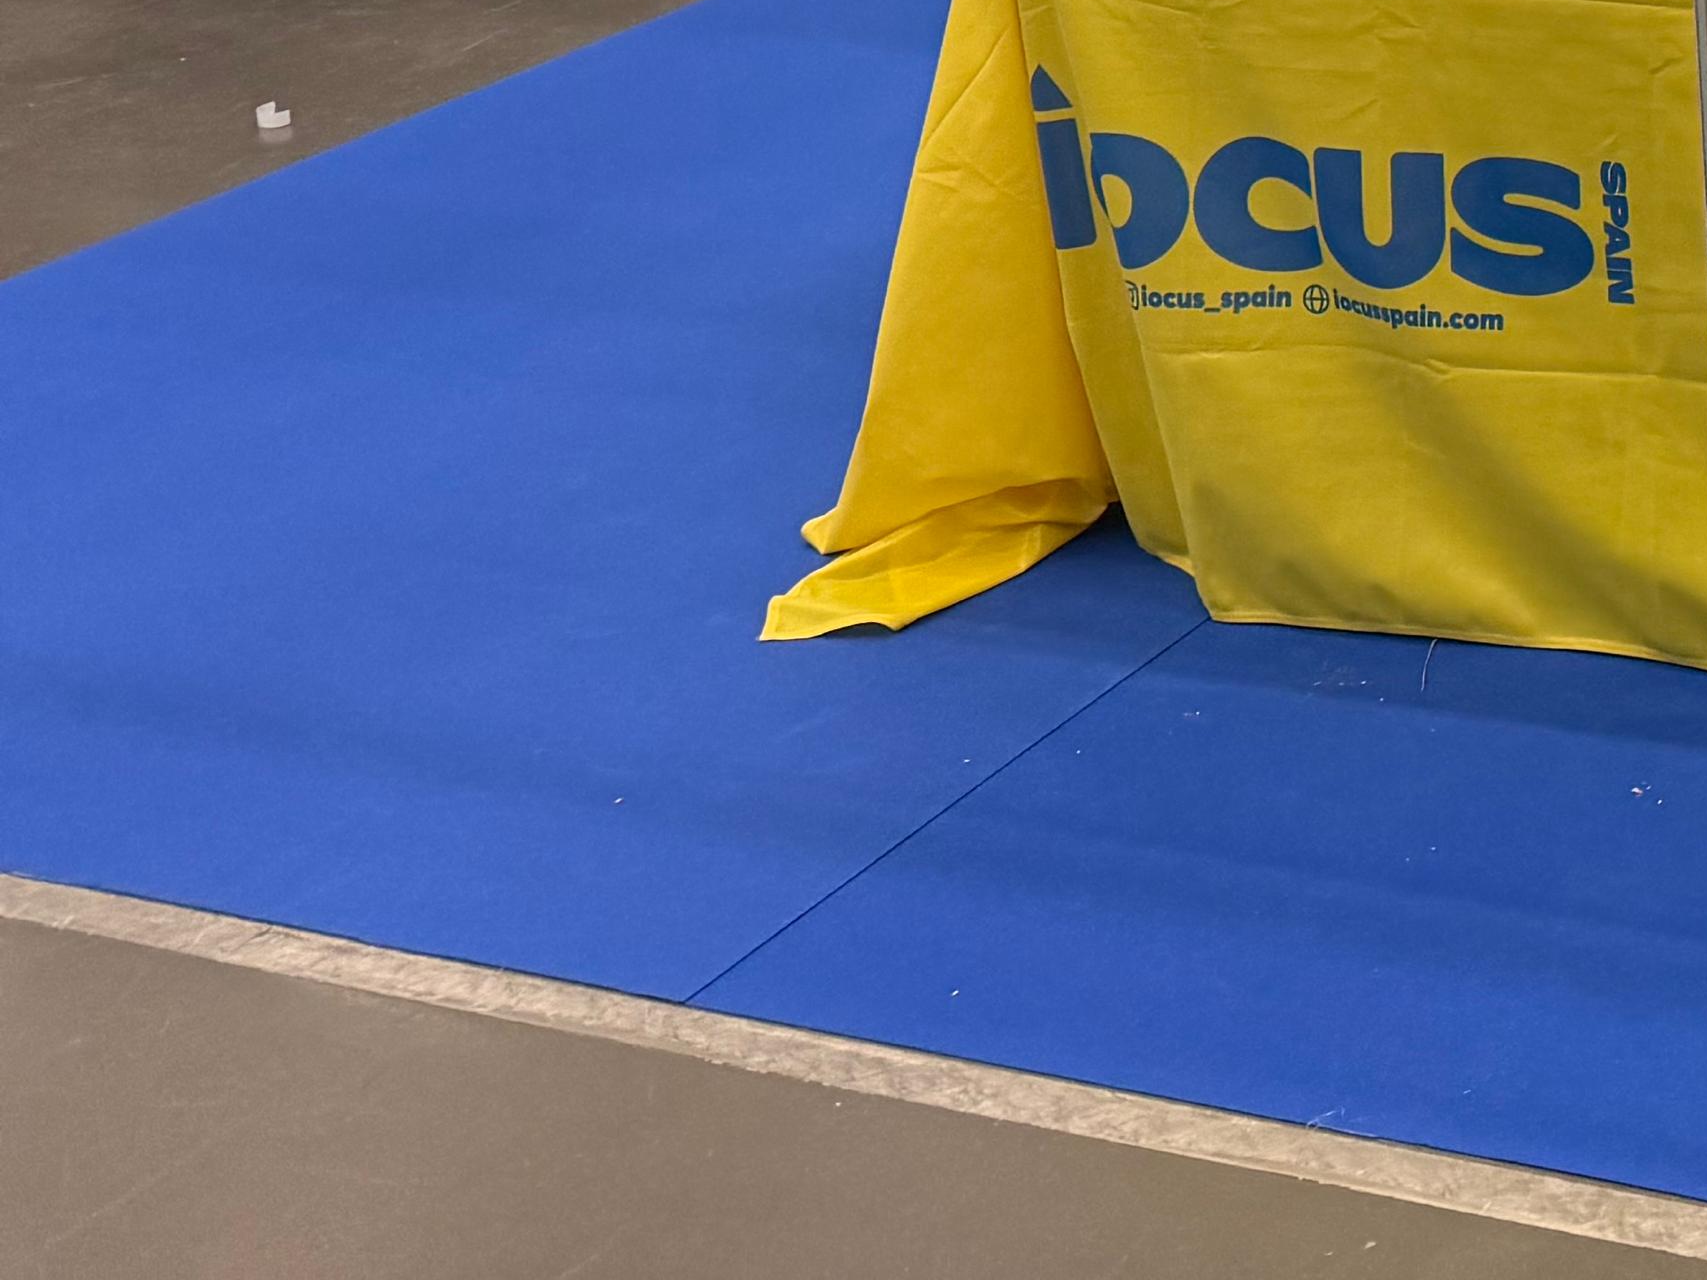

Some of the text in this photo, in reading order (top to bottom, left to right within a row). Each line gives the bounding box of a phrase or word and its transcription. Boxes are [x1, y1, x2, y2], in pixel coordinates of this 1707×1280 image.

[1600, 161, 1636, 305] SPAIN
[1141, 283, 1505, 332] iocus_spain iocusspain.com
